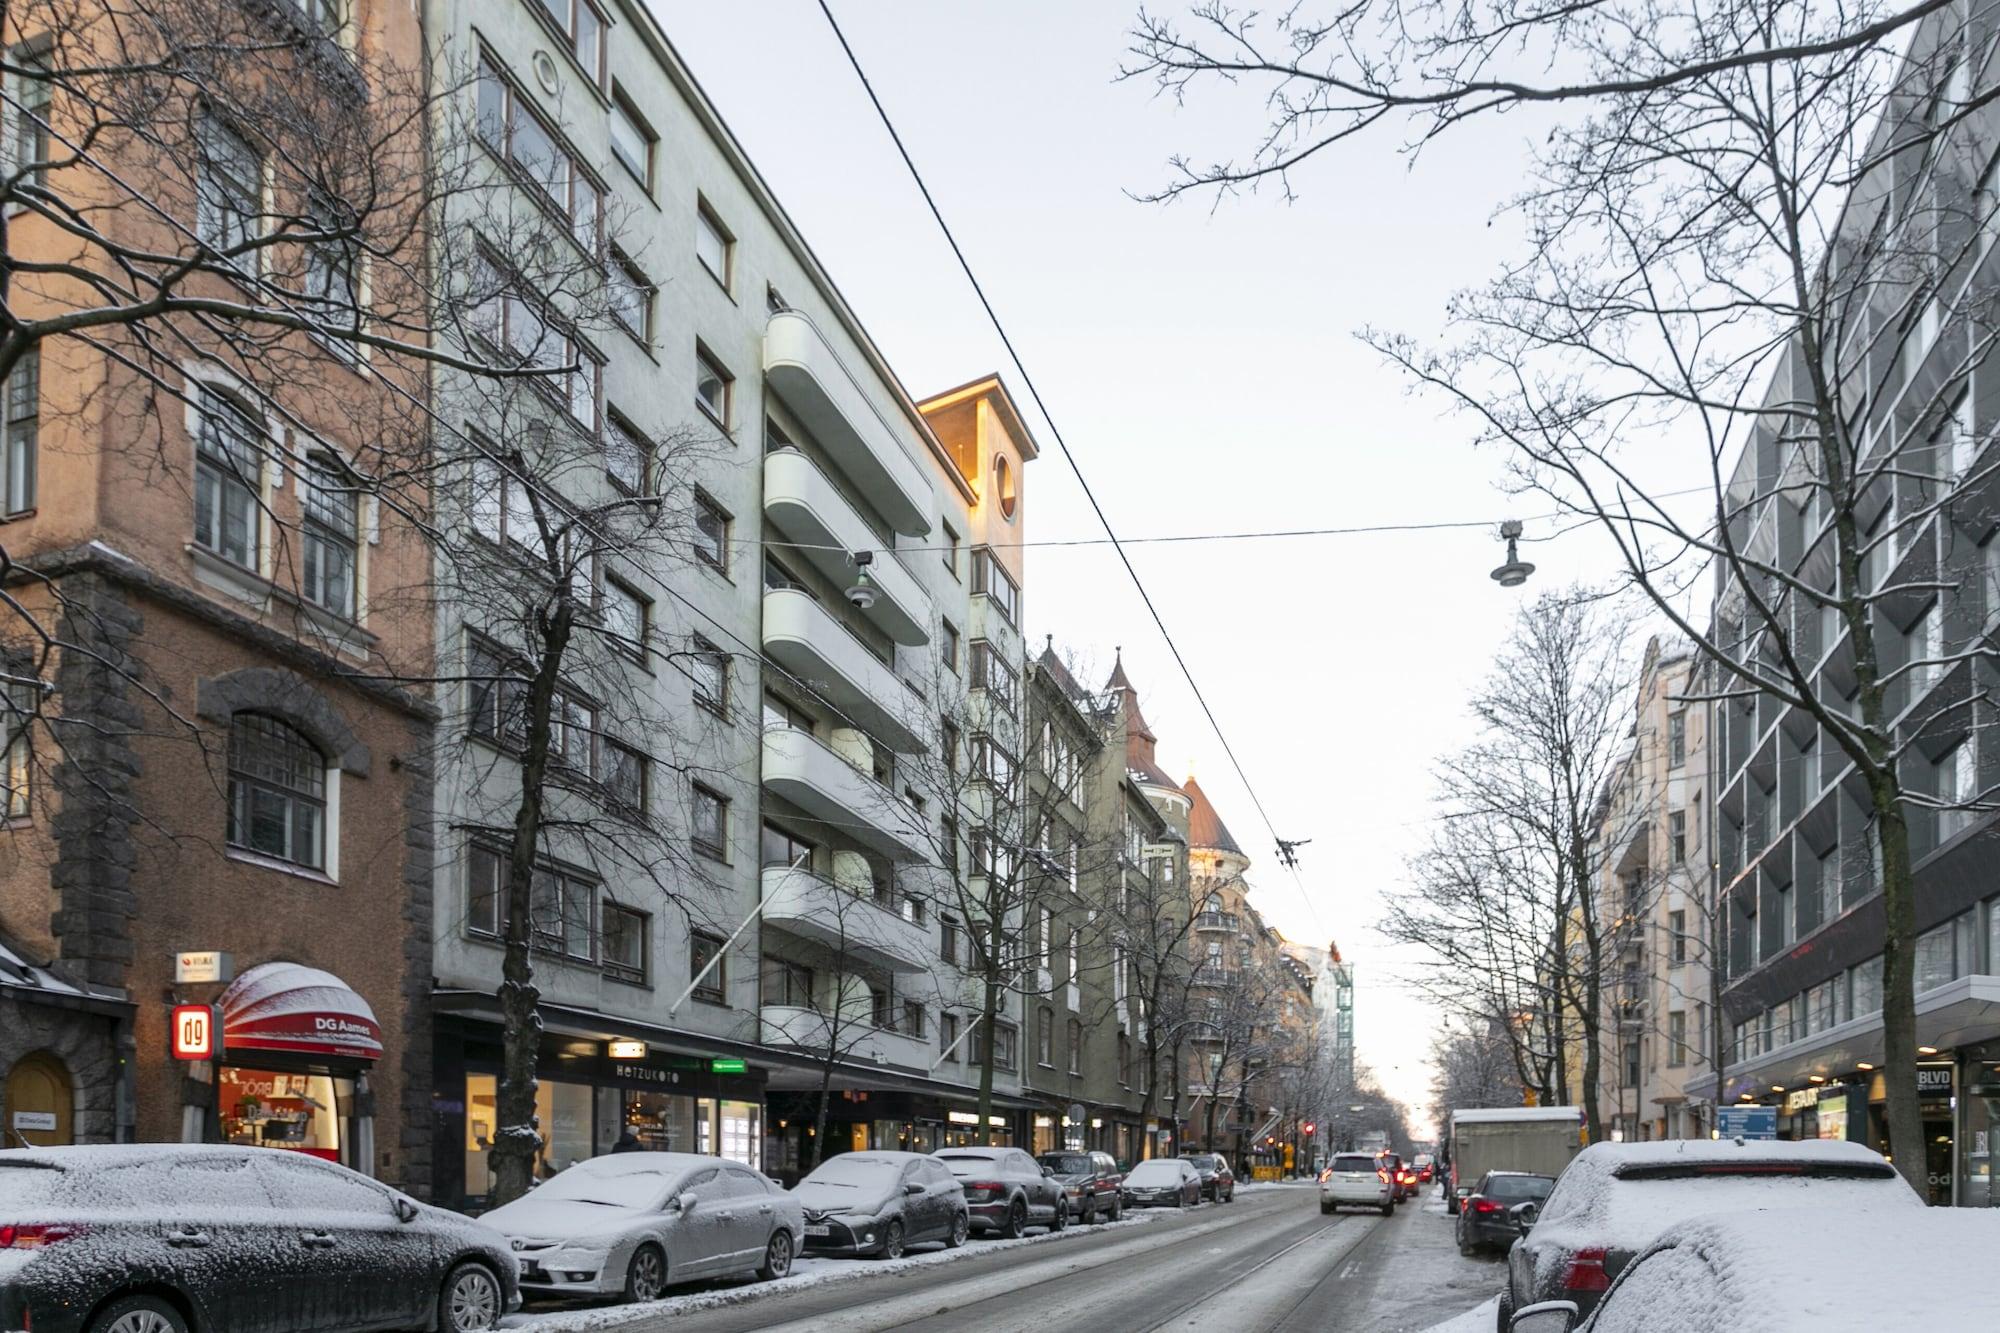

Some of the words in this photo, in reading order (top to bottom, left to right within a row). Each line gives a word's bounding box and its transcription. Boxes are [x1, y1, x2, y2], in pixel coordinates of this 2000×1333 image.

[315, 1016, 337, 1030] DG
[184, 1018, 202, 1046] dg
[1918, 1070, 1951, 1085] BLVD
